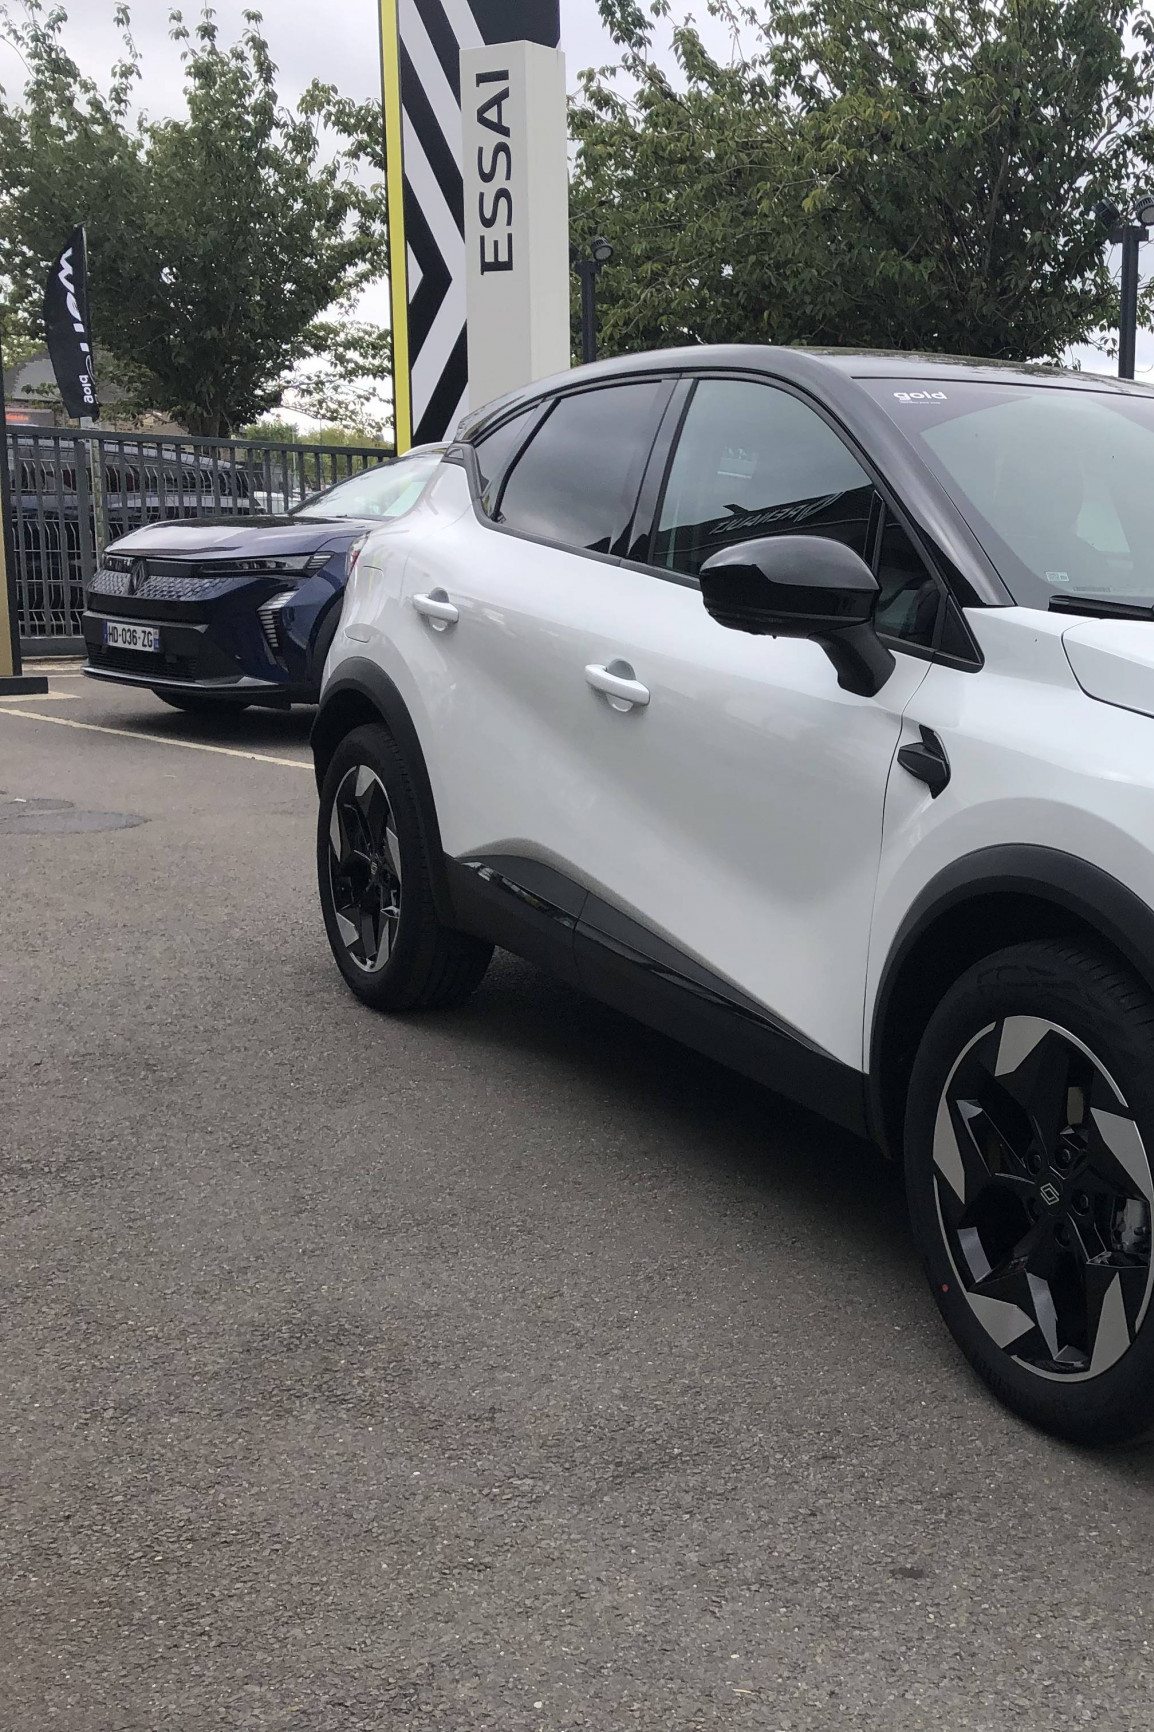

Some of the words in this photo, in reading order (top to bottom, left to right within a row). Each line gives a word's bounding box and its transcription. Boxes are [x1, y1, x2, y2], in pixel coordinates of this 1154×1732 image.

[475, 69, 514, 275] ESSAI
[893, 390, 948, 401] gold
[108, 625, 153, 649] HD-036-ZG
